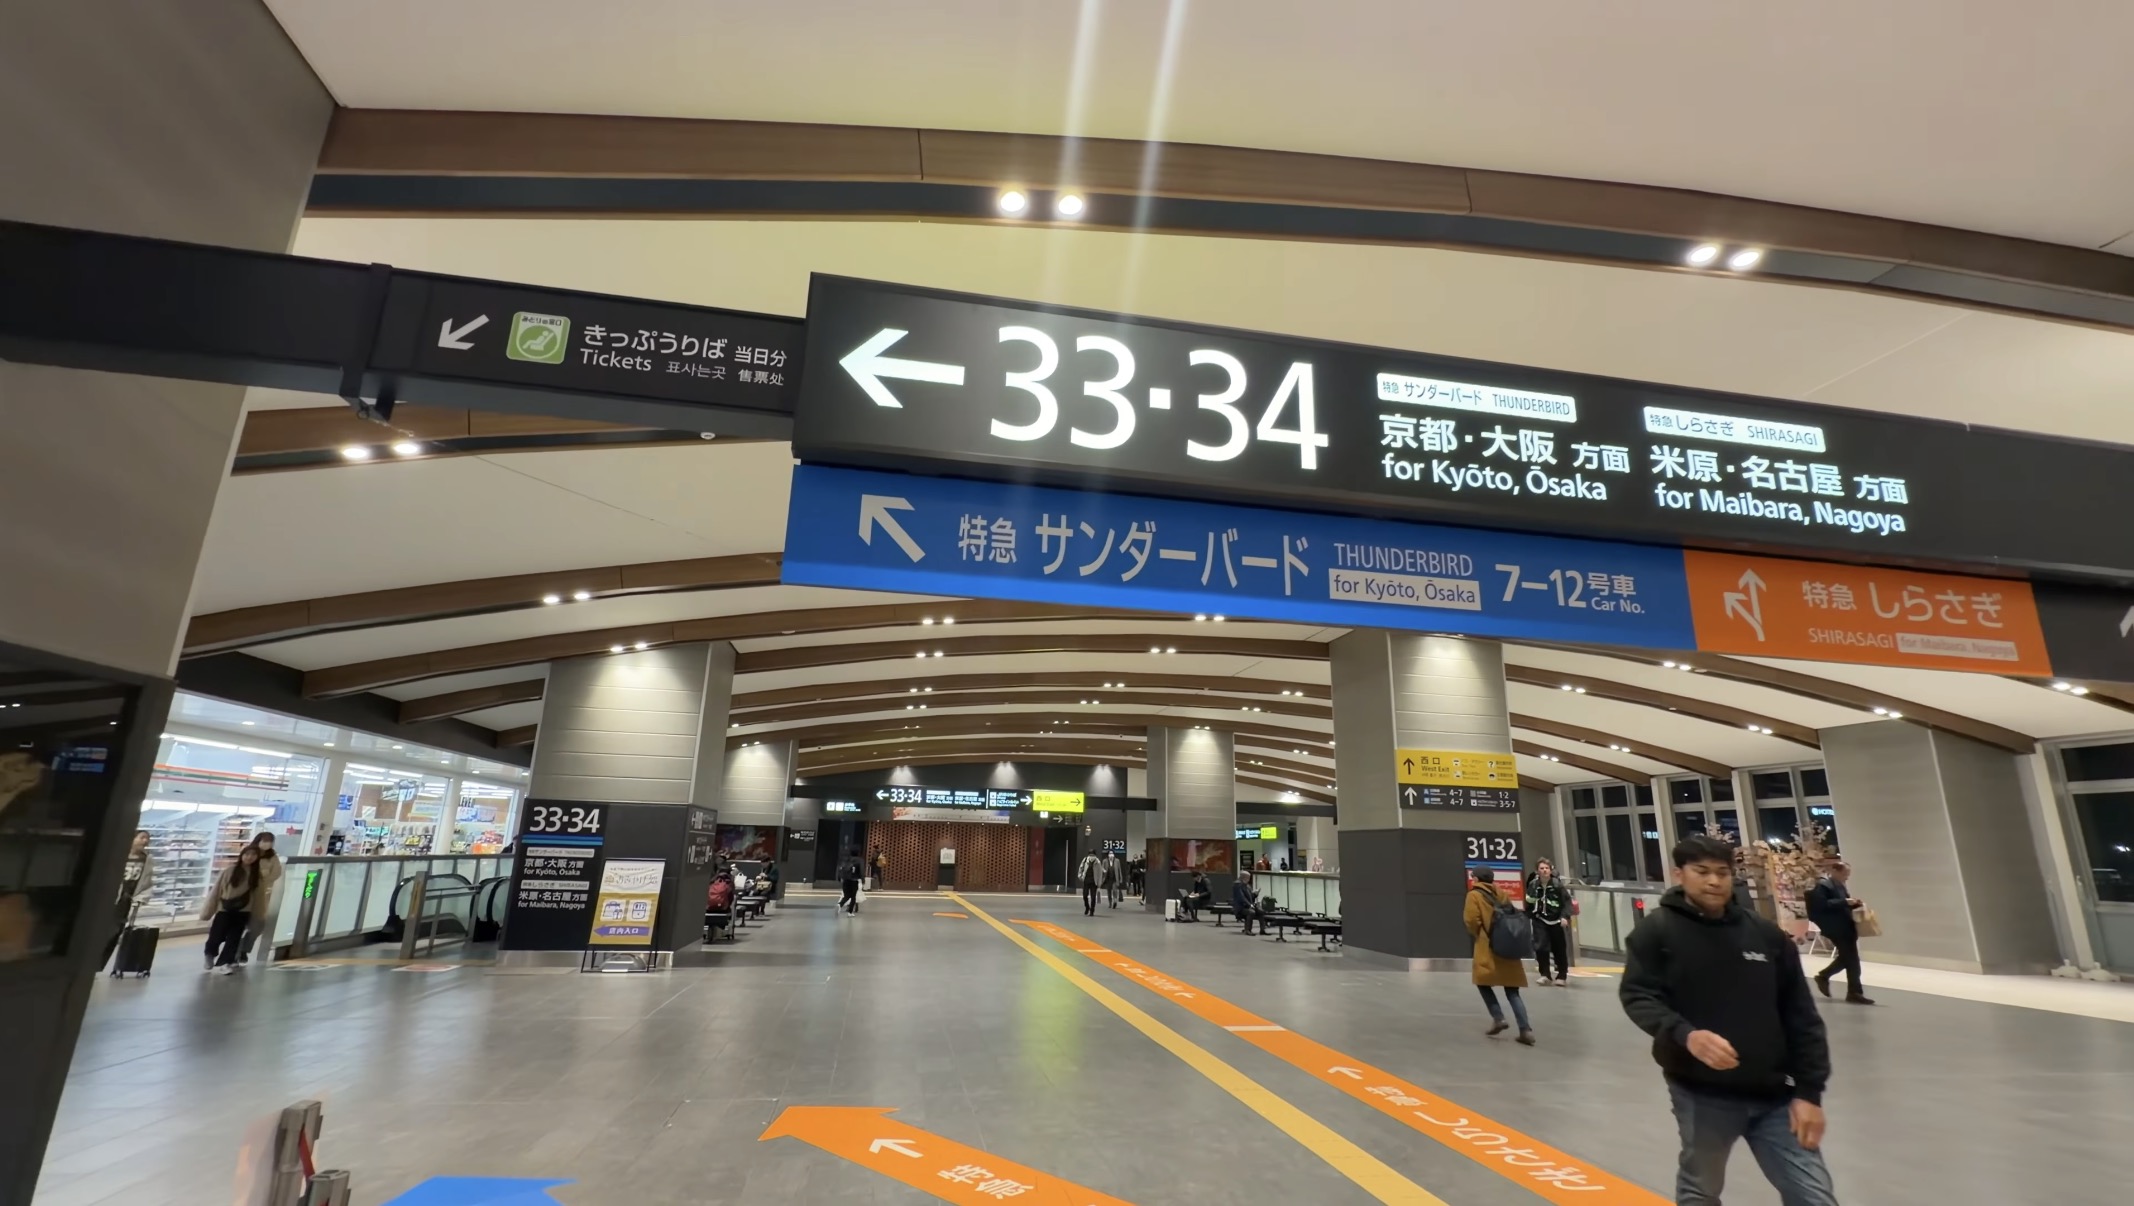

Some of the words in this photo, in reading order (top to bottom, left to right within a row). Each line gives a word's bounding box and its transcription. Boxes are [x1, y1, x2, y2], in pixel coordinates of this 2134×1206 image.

[580, 348, 652, 372] Tickets
[583, 324, 728, 359] きっぷうりば
[734, 345, 788, 368] 当日分
[738, 368, 785, 387] 售票处
[1404, 381, 1482, 405] サンダーバード
[1492, 394, 1570, 415] THUNDERBIRD
[1676, 414, 1734, 436] しらさぎ
[1748, 425, 1818, 446] SHIRASAGI
[1572, 441, 1630, 474] 方面
[1381, 454, 1422, 482] for
[1432, 461, 1519, 497] Kyōto,
[1527, 466, 1608, 501] Ōsaka
[1854, 473, 1908, 505] 方面
[1654, 483, 1695, 511] for
[1701, 489, 1810, 526] Maibara,
[1815, 502, 1906, 534] Nagoya
[958, 514, 1018, 564] 特急
[1035, 513, 1310, 596] サンダーバード
[1334, 543, 1473, 577] THUNDERBIRD
[1334, 575, 1360, 594] for
[1366, 578, 1420, 602] Kyōto,
[1425, 580, 1476, 604] Ōsaka
[1587, 572, 1637, 598] 号車
[1591, 597, 1615, 612] Car
[1620, 598, 1645, 614] No.
[1802, 580, 1857, 611] 特急
[1868, 582, 2004, 629] しらさぎ
[1808, 627, 1894, 649] SHIRASAGI
